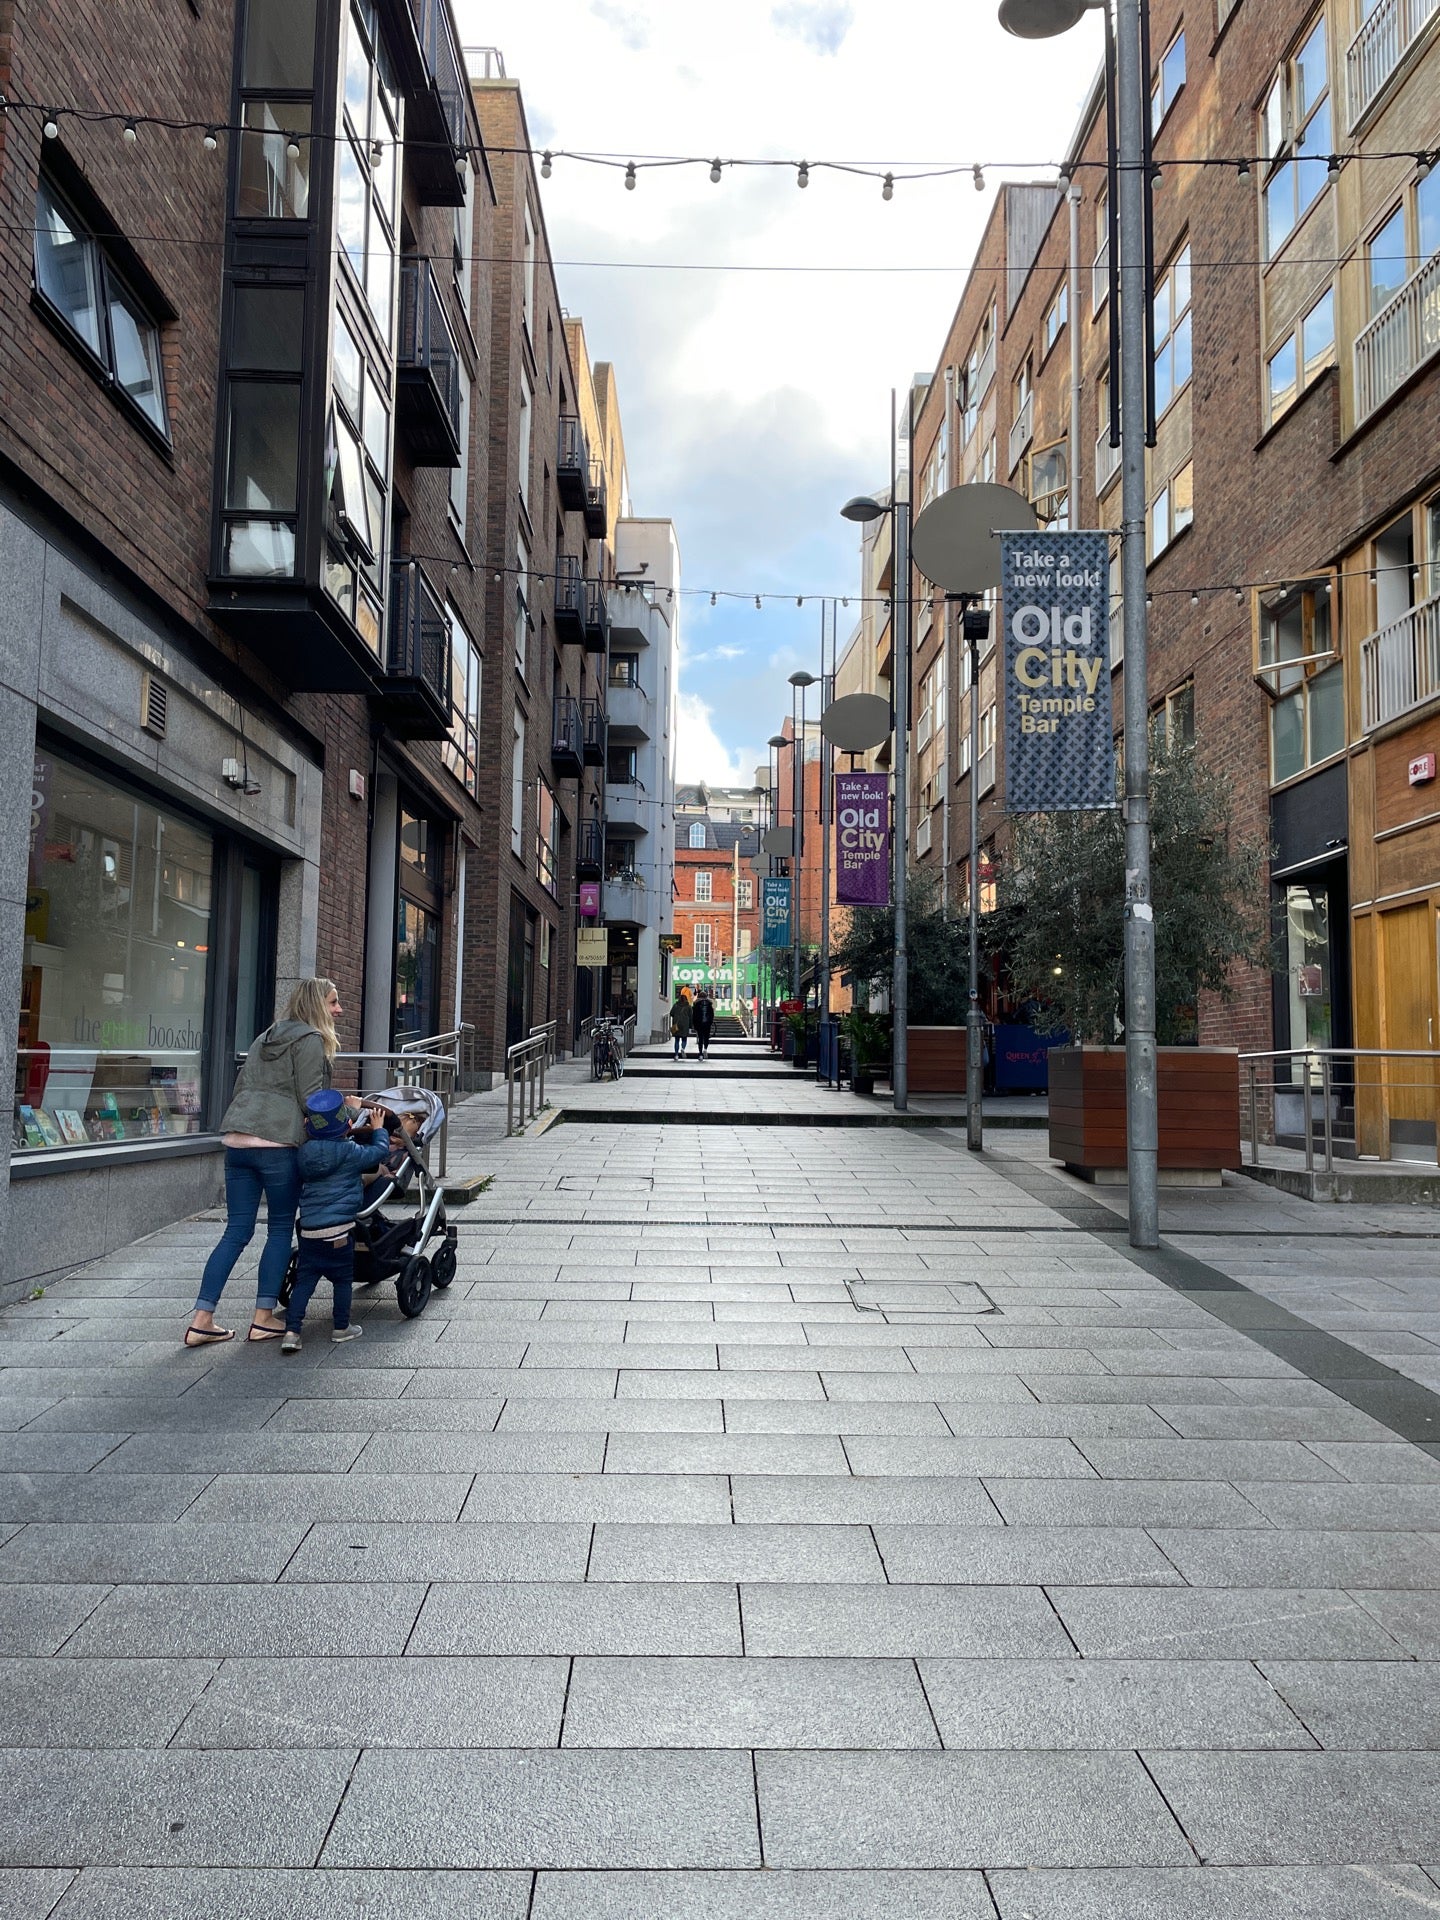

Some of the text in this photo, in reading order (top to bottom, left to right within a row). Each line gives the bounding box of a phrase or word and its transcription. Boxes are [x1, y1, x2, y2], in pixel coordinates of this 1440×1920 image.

[1012, 550, 1071, 568] Take a
[1013, 570, 1101, 587] new look!
[1011, 605, 1092, 645] Old
[1014, 647, 1103, 695] City
[1017, 694, 1096, 717] Temple
[1021, 715, 1060, 734] Bar
[840, 782, 862, 791] Take
[861, 791, 884, 800] look!
[839, 808, 880, 828] Old
[841, 828, 885, 852] City
[842, 850, 881, 862] Temple
[843, 860, 863, 869] Bar
[766, 895, 787, 907] Old
[766, 906, 790, 919] City
[1006, 1051, 1030, 1063] QUEEN
